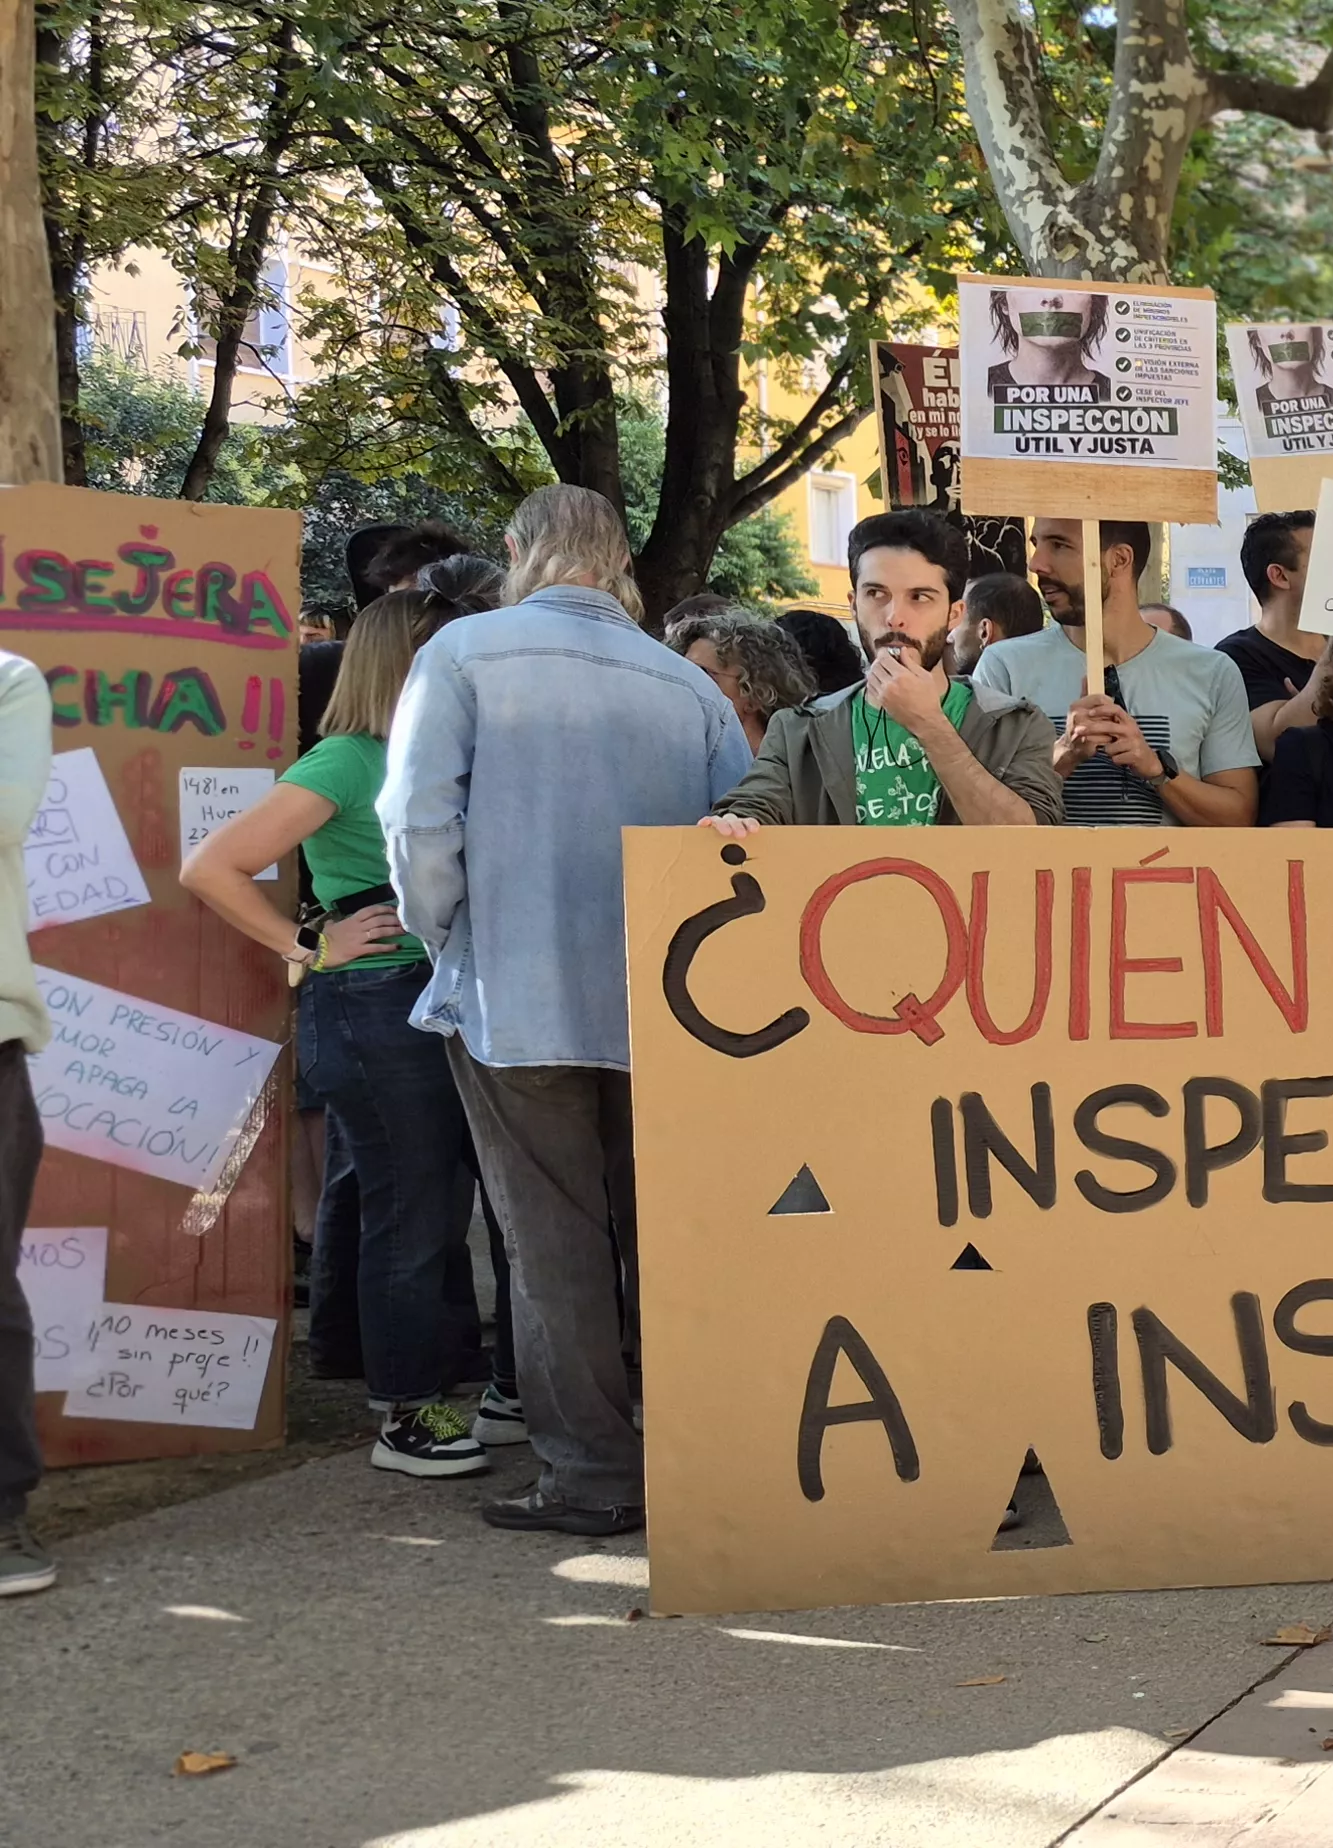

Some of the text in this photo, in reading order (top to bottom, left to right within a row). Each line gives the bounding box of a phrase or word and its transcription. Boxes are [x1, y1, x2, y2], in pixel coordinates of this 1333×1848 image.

[1006, 386, 1094, 404] POR UNA
[1271, 397, 1326, 414] POR UNA
[909, 408, 945, 423] en mi
[1003, 407, 1170, 433] INSPECCIÓN
[916, 427, 923, 440] y
[926, 427, 937, 437] se
[940, 424, 949, 437] lo
[1282, 437, 1315, 451] ÚTIL
[1316, 435, 1327, 447] Y
[1015, 433, 1155, 455] ÚTIL Y JUSTA
[220, 784, 240, 796] en
[663, 843, 1309, 1058] ¿QUIÉN
[37, 979, 94, 1018] ON
[109, 1003, 223, 1056] PRESIÓN
[65, 1060, 199, 1120] APAGA LA
[145, 1324, 225, 1345] meses
[118, 1348, 152, 1361] sin
[169, 1351, 230, 1378] profe
[172, 1381, 230, 1416] qué?
[799, 1315, 919, 1501] A
